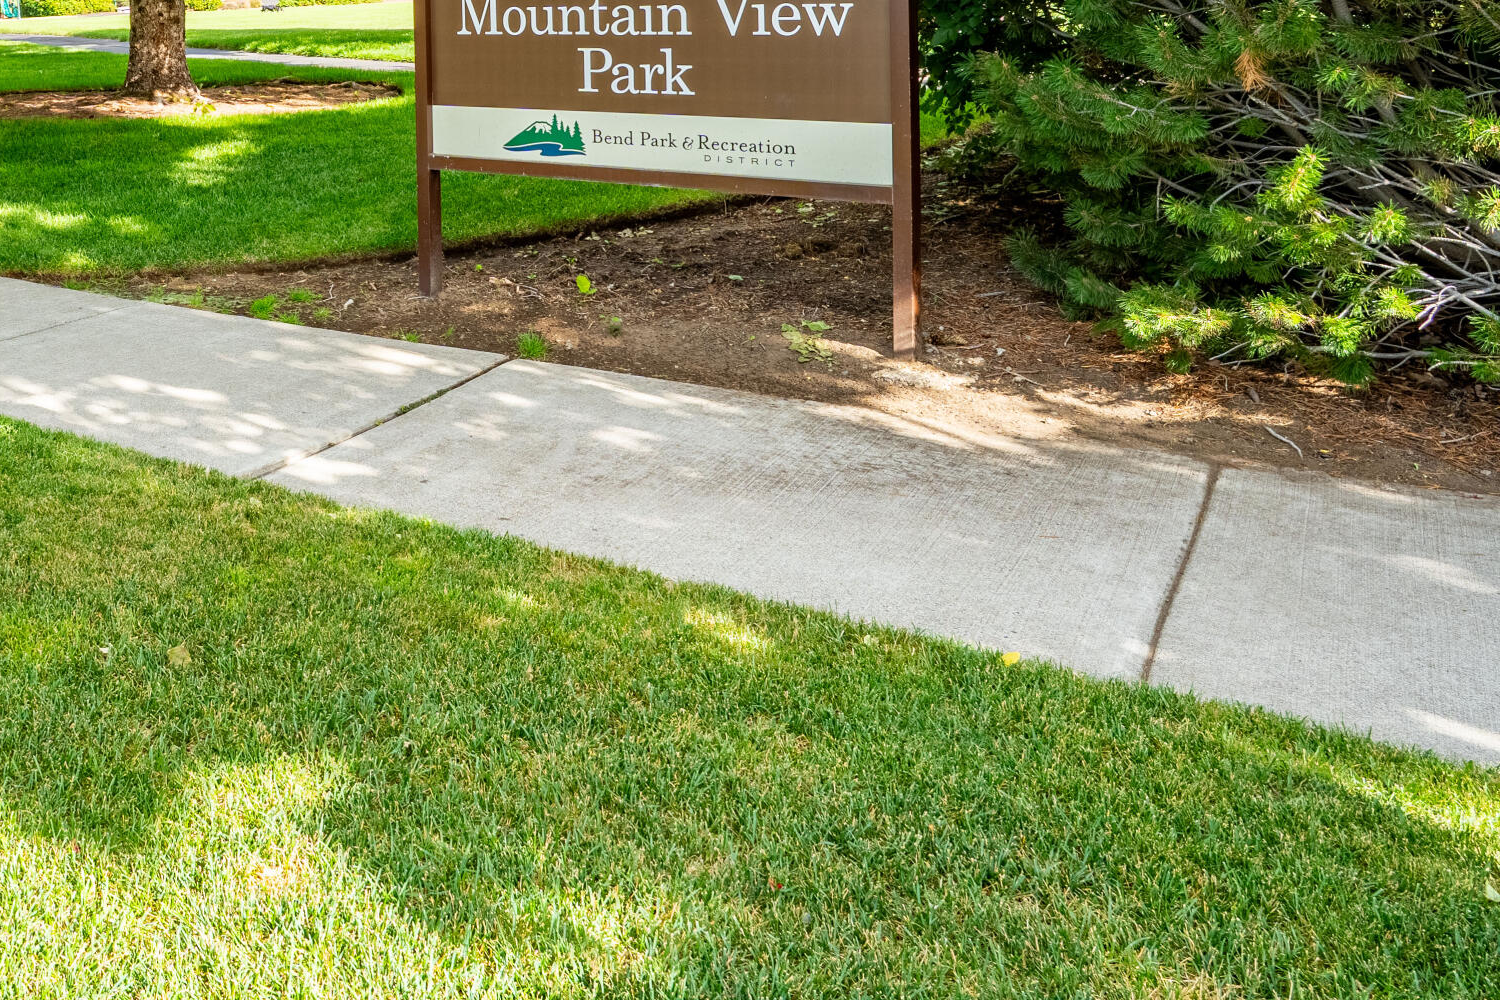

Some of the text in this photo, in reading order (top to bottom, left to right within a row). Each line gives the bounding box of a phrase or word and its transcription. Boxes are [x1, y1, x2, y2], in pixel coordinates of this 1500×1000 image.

[577, 47, 696, 96] Park
[591, 128, 797, 155] Bend Park & Recreation
[703, 154, 796, 168] DISTRICT
